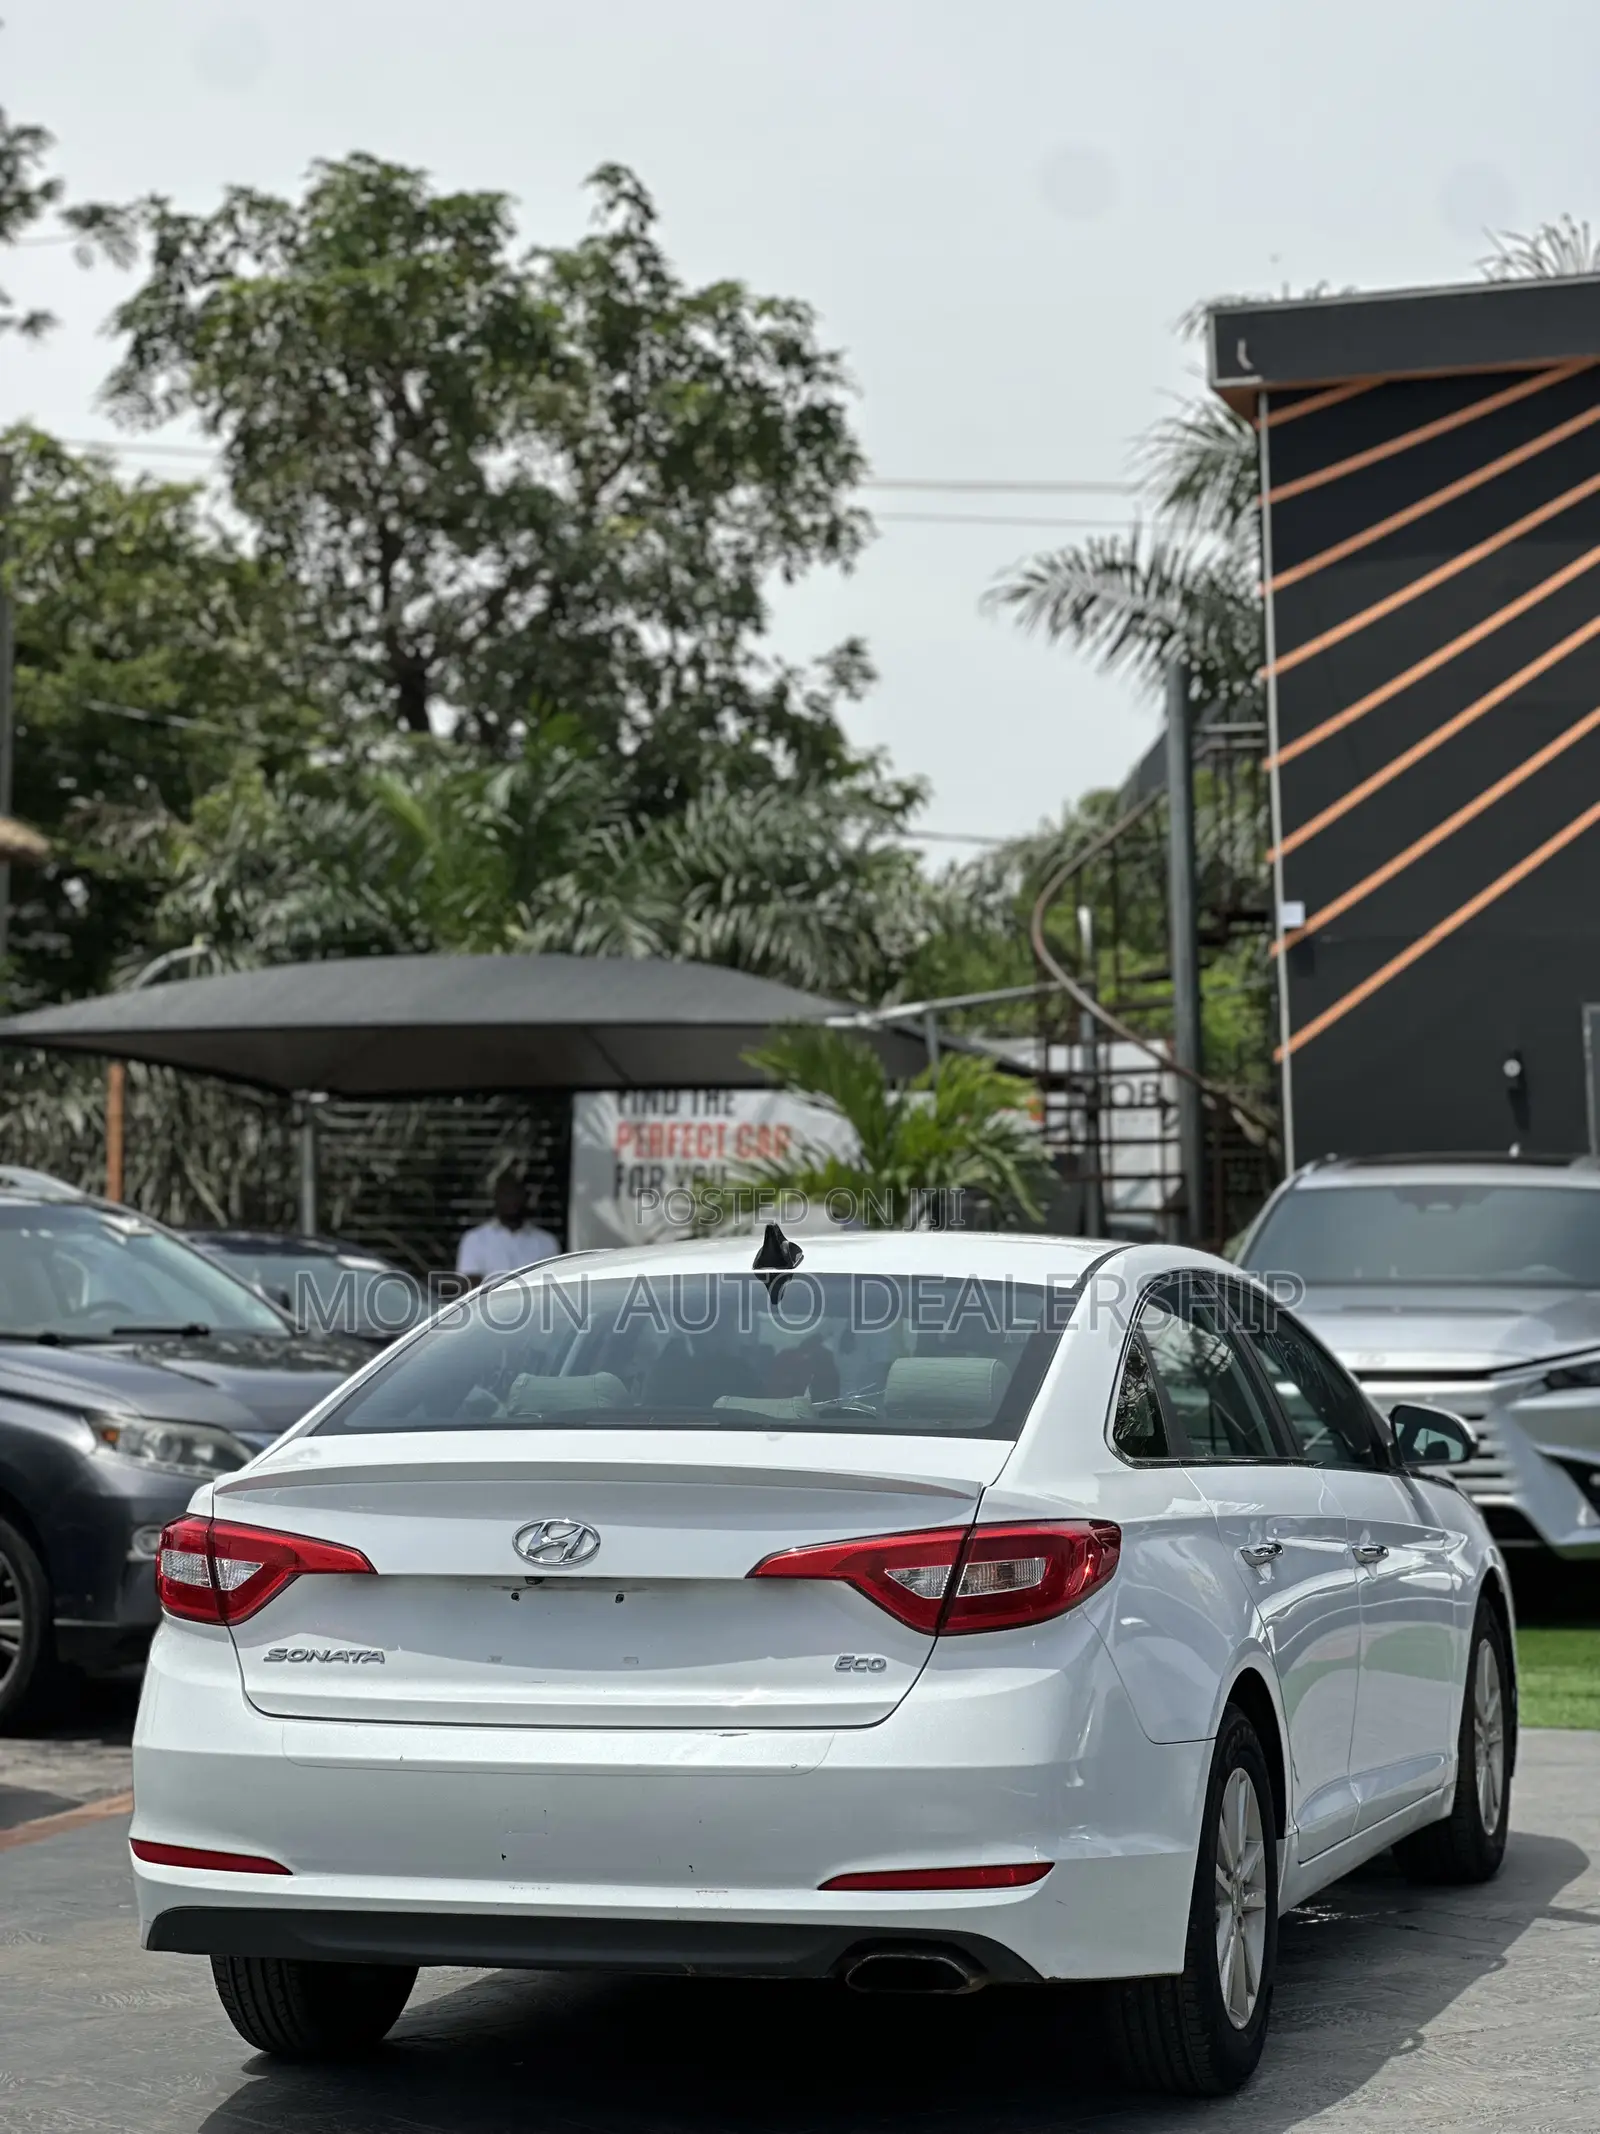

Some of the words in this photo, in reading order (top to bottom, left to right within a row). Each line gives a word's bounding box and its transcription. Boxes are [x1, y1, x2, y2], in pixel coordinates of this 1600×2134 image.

[615, 1120, 727, 1160] PERFECT
[613, 1161, 667, 1199] FOR
[264, 1647, 386, 1665] SONATA
